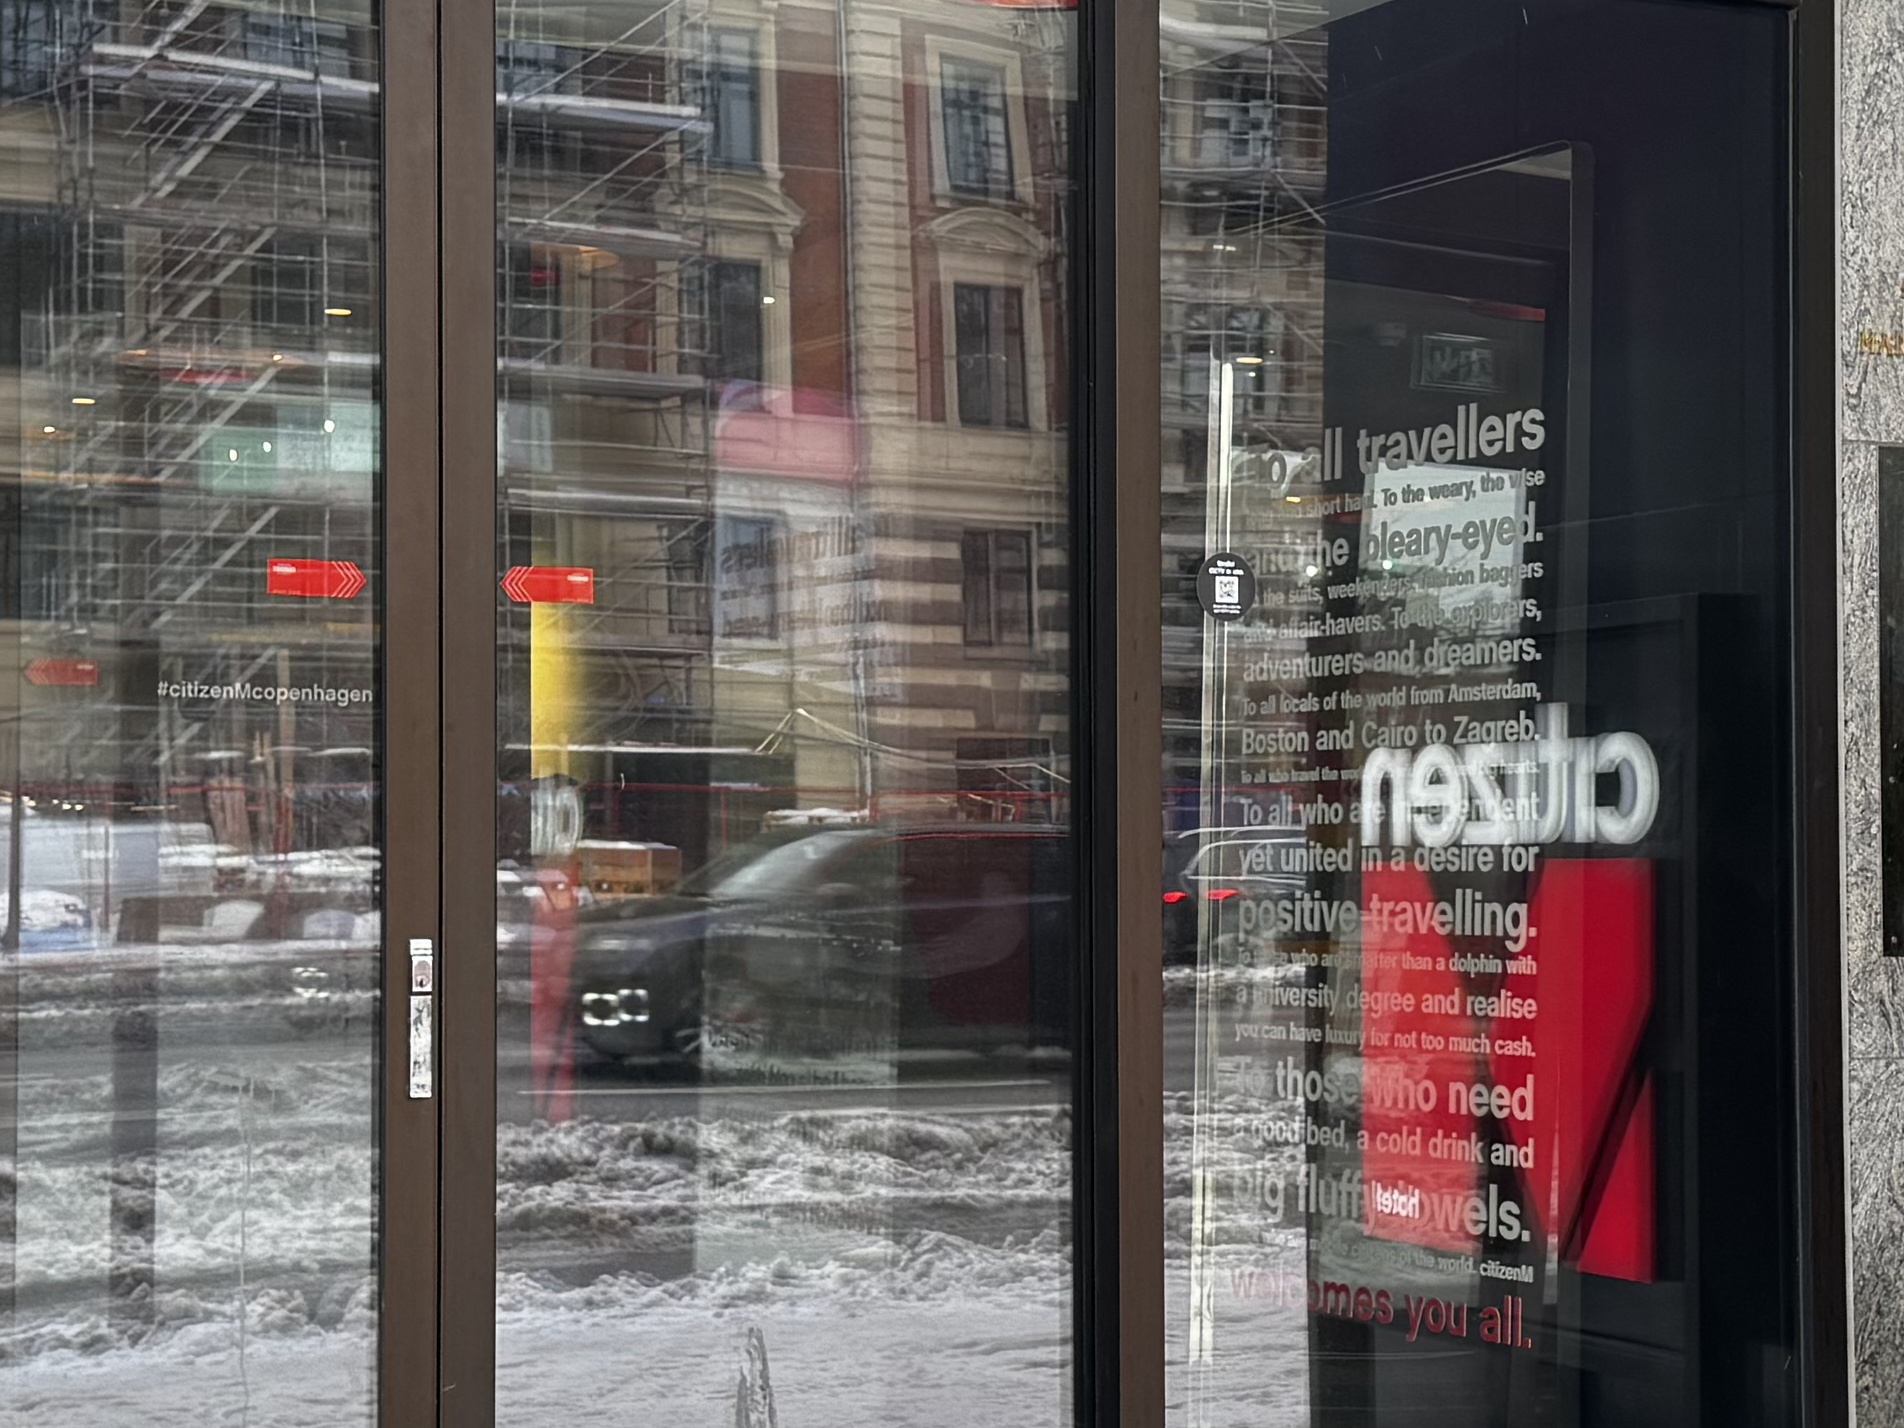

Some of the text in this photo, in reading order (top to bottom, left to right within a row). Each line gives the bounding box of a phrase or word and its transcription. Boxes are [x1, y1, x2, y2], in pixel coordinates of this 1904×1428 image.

[1357, 403, 1545, 475] travellers
[1381, 488, 1397, 508] To
[1402, 483, 1425, 504] the
[1429, 478, 1476, 502] weary,
[1366, 501, 1544, 566] bleary-eyed.
[1288, 582, 1323, 604] suits,
[1391, 606, 1409, 631] To
[1243, 650, 1365, 684] adventurers
[1424, 637, 1542, 668] dreamers.
[157, 680, 374, 707] #citizenMcopenhagen
[1242, 678, 1541, 717] To all locals of the world from Amsterdam,
[1242, 710, 1540, 755] Boston and Cairo to Zagreb.
[1239, 799, 1262, 826] To
[1268, 795, 1293, 826] all
[1299, 794, 1343, 824] who
[1349, 802, 1386, 822] ae
[1239, 838, 1540, 876] yet united in a desire for
[1238, 888, 1537, 952] positive travelling.
[1402, 951, 1432, 971] than
[1436, 956, 1445, 970] a
[1449, 952, 1502, 977] dolphin
[1506, 954, 1537, 975] with
[1346, 983, 1415, 1018] degree
[1421, 988, 1460, 1015] and
[1466, 988, 1537, 1020] realise
[1263, 1025, 1285, 1040] can
[1289, 1021, 1322, 1043] have
[1325, 1023, 1366, 1051] luxury
[1371, 1026, 1391, 1046] for
[1394, 1029, 1417, 1049] not
[1421, 1031, 1445, 1051] too
[1449, 1034, 1490, 1055] much
[1495, 1035, 1536, 1058] cash.
[1276, 1056, 1360, 1103] those
[1368, 1066, 1437, 1113] who
[1449, 1073, 1535, 1121] need
[1307, 1116, 1349, 1153] bed,
[1357, 1128, 1369, 1152] a
[1376, 1125, 1422, 1157] cold
[1428, 1128, 1484, 1163] drink
[1490, 1137, 1535, 1169] and
[1386, 1183, 1531, 1243] wels.
[1414, 1250, 1434, 1269] the
[1479, 1259, 1534, 1284] citizenM
[1405, 1294, 1467, 1342] you
[1479, 1294, 1532, 1349] all.
